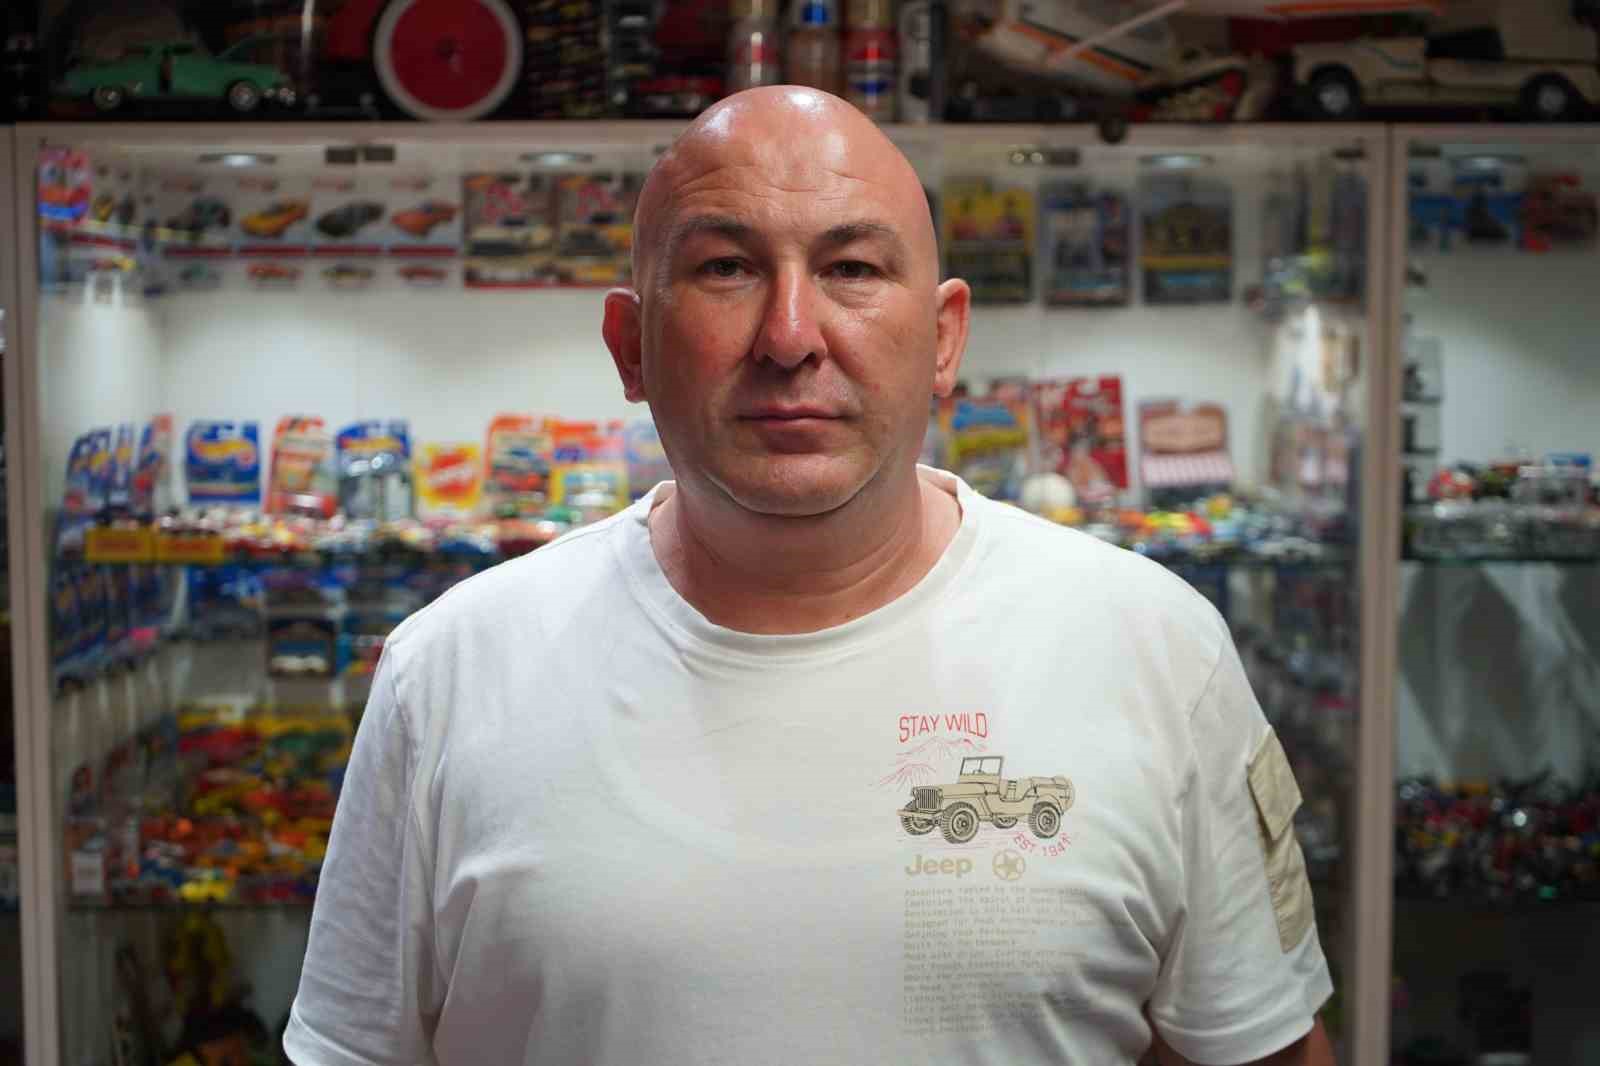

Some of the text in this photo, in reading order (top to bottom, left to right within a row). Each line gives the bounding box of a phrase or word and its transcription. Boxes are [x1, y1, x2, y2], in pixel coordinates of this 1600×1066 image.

[899, 712, 987, 742] STAY WILD
[905, 855, 972, 877] Jeep
